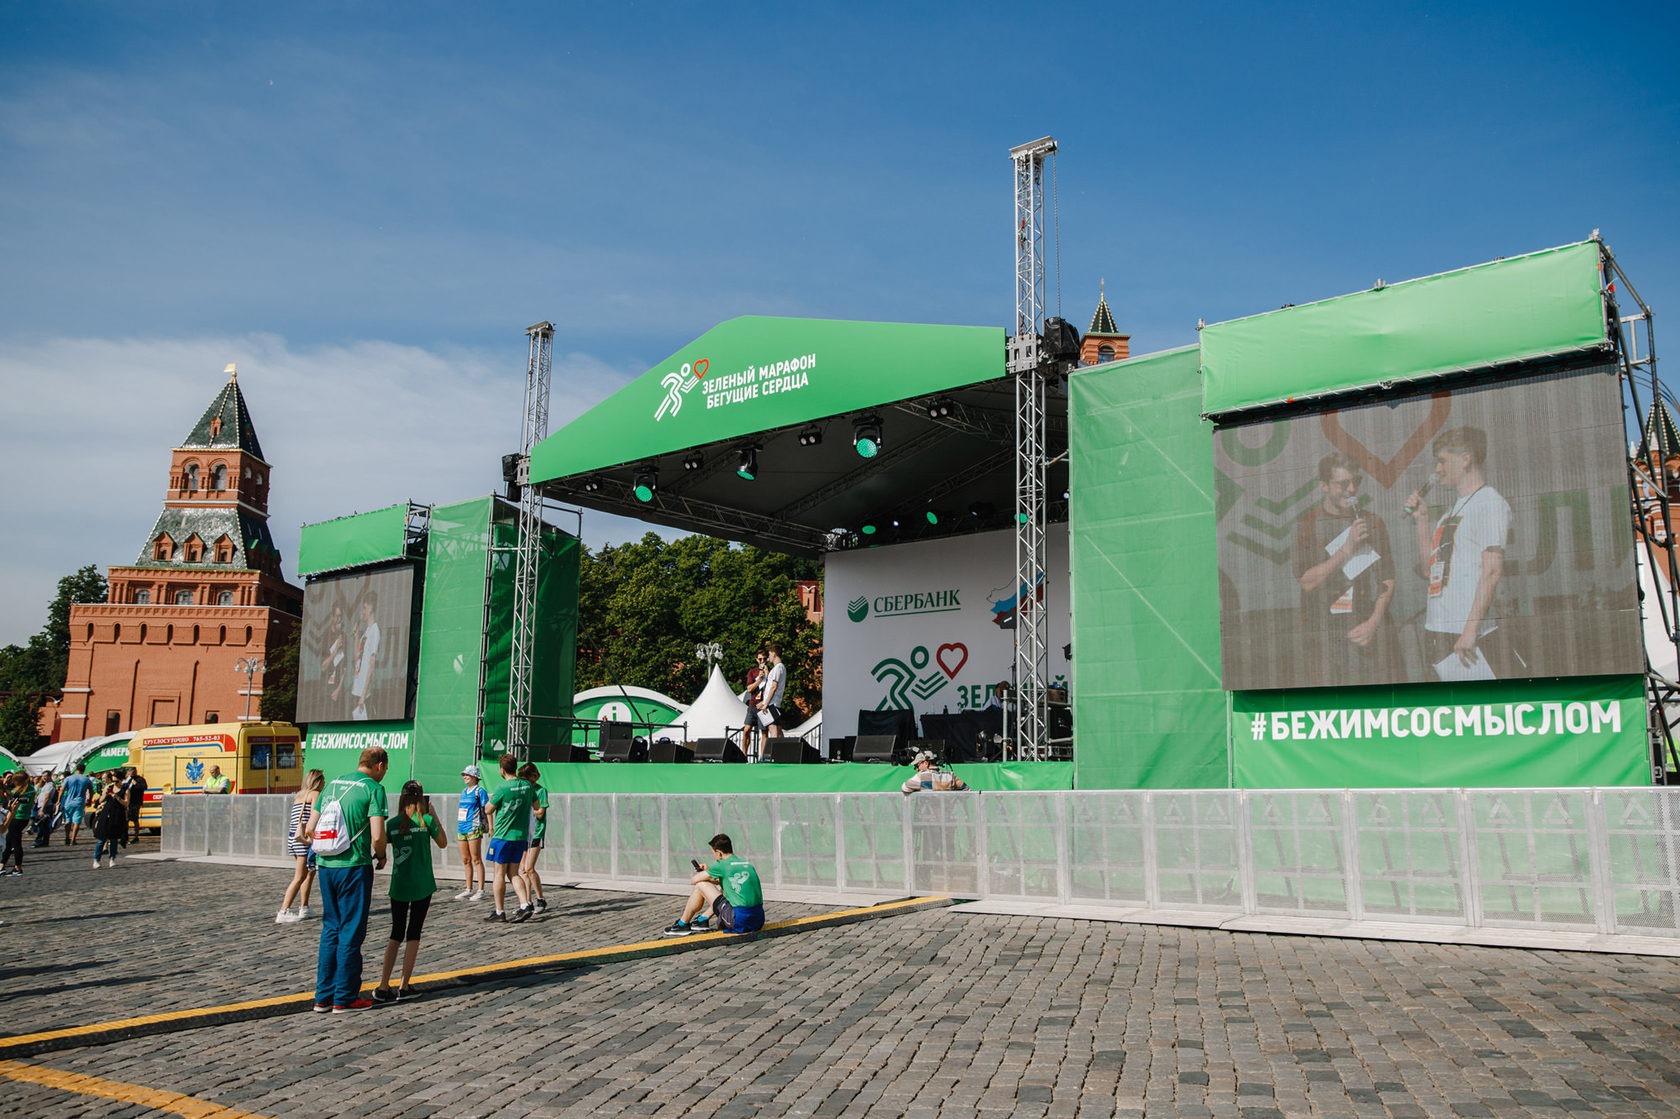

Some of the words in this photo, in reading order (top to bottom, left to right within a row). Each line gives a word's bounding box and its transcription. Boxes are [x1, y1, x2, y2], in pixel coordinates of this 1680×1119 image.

[702, 365, 756, 395] ЗЕЛЕНЫЙ
[759, 353, 817, 379] МАРАФОН
[706, 384, 759, 409] БЕГУЩИЕ
[762, 372, 809, 396] СЕРДЦА
[874, 588, 961, 613] СБЕРБАНК
[1250, 700, 1623, 741] #БЕЖИМСОСМЫСЛОМ
[310, 732, 409, 749] #БЕЖИМСОСМЫСЛОМ
